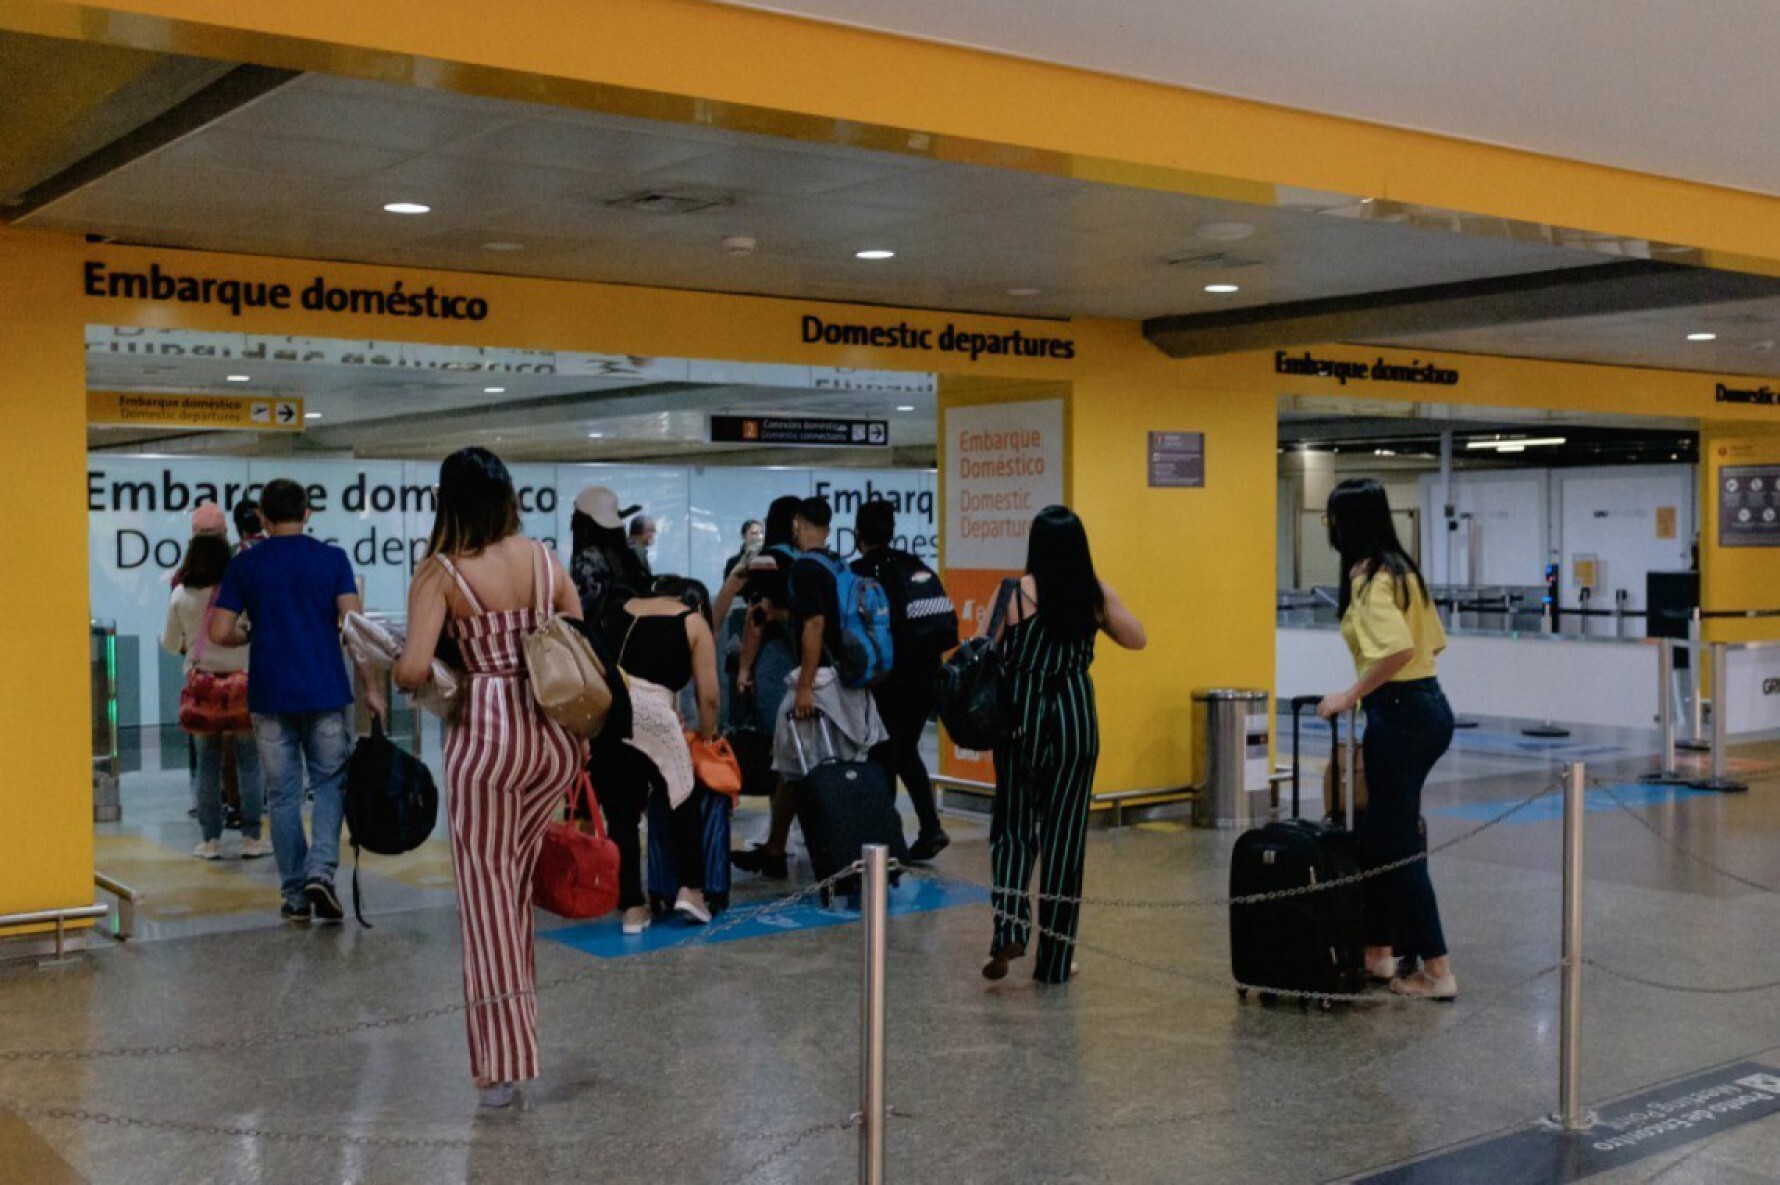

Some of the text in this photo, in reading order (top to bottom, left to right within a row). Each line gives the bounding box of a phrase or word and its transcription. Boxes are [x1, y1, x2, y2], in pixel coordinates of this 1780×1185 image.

[84, 261, 489, 322] Embarque doméstico
[802, 314, 1075, 361] Domestic departures
[1276, 351, 1459, 385] Embarque doméstico
[119, 394, 179, 411] Embarque
[959, 429, 1042, 454] Embarque
[960, 453, 1045, 480] Doméstico
[87, 469, 557, 513] Embare domco
[961, 488, 1032, 512] Domestic
[961, 516, 1029, 542] Departur
